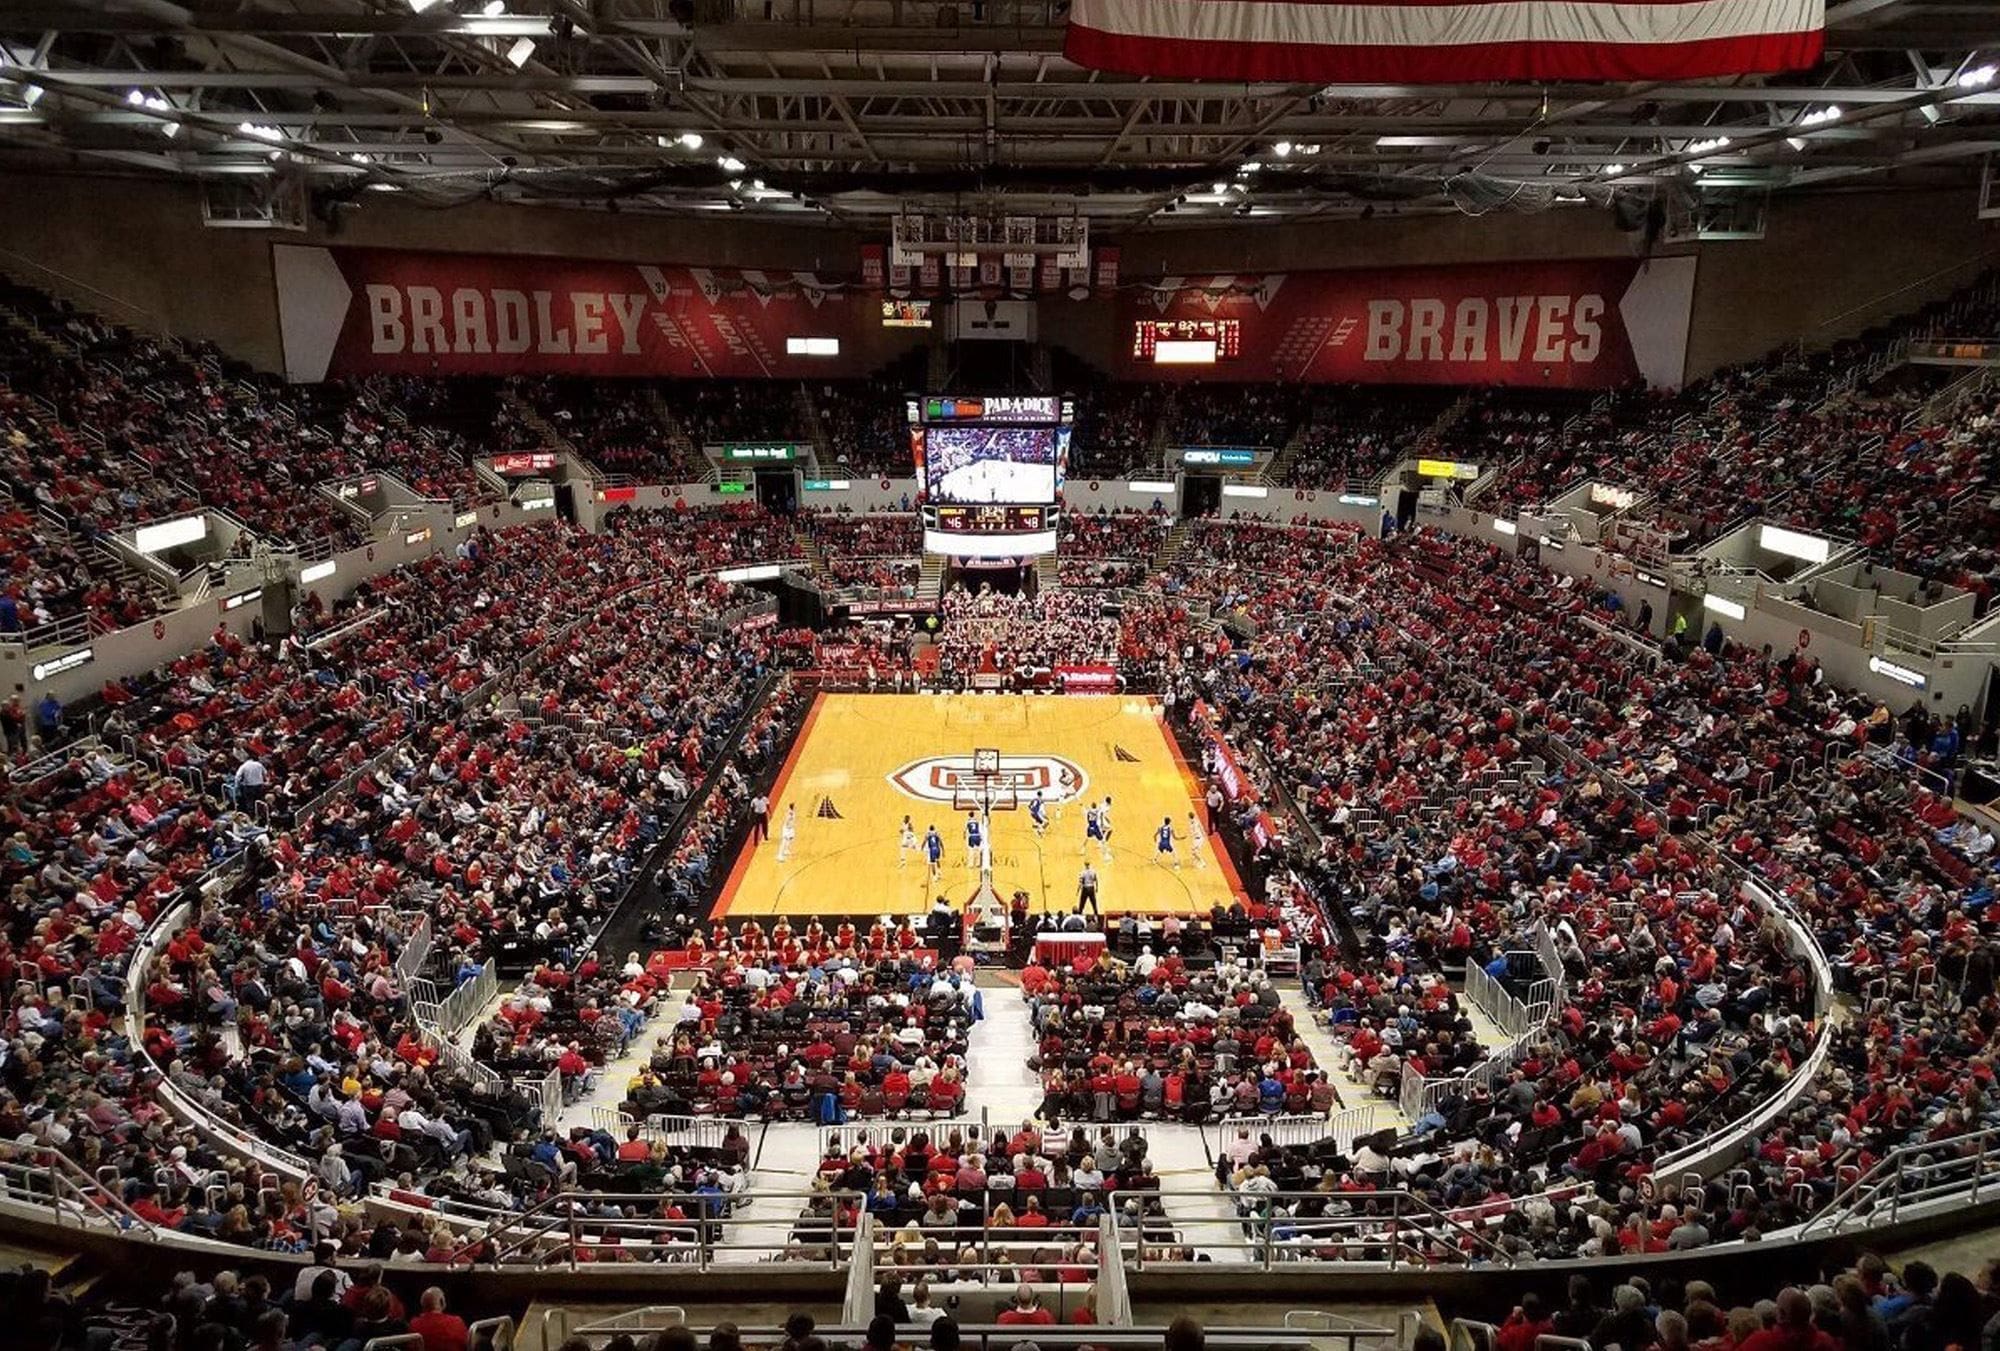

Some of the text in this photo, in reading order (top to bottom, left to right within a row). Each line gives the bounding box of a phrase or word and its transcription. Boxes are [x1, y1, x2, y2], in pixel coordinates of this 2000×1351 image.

[366, 284, 647, 354] BRADLEY
[1364, 293, 1605, 363] BRAVES
[947, 517, 962, 528] 46
[1024, 517, 1039, 528] 48
